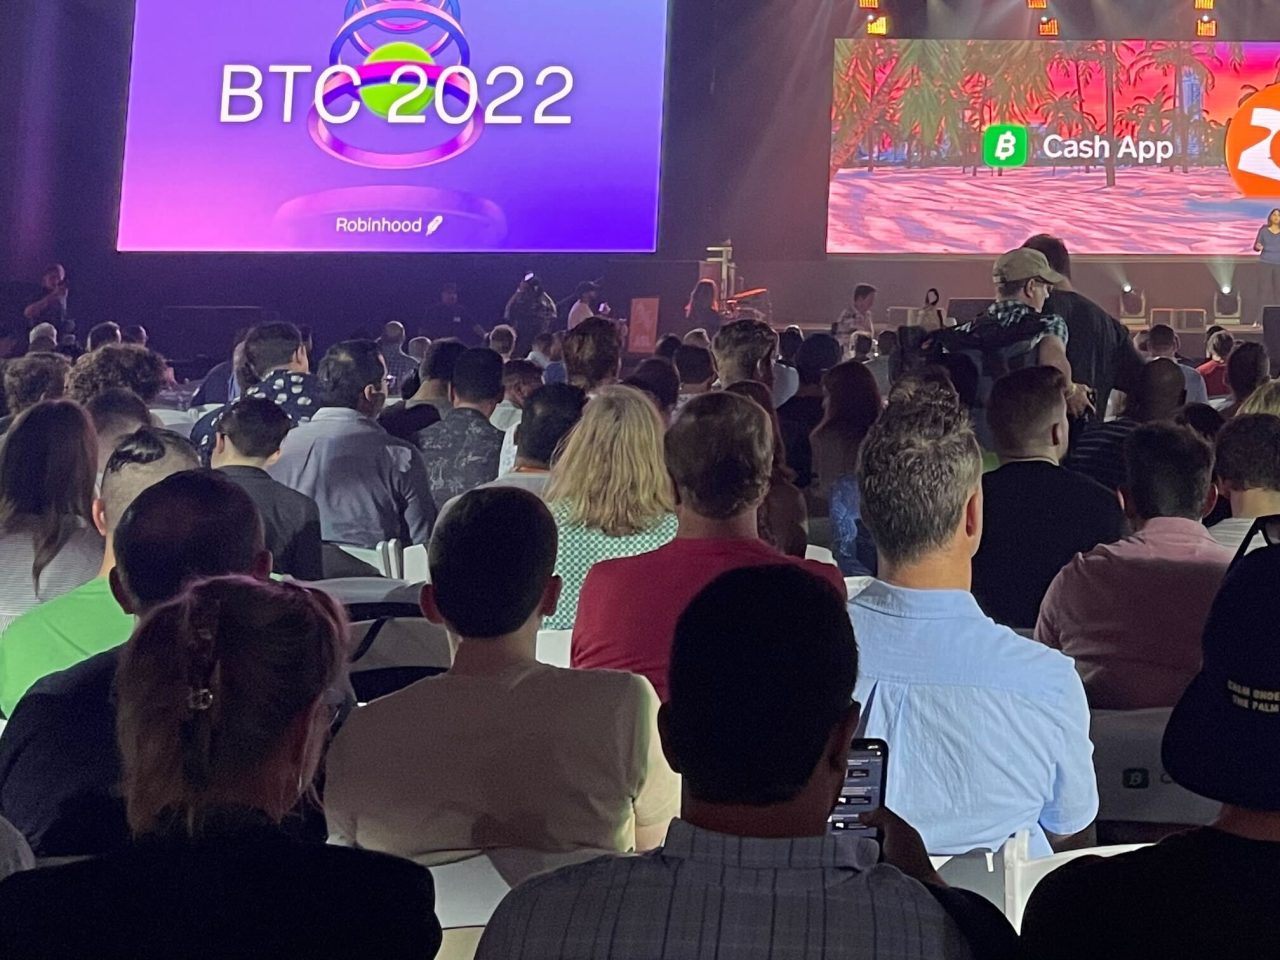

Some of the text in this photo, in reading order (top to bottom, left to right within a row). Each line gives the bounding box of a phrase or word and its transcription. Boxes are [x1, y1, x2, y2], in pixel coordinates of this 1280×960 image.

[219, 63, 575, 125] BTC 2022
[1043, 133, 1110, 159] Cash
[1117, 134, 1174, 164] App
[335, 216, 422, 234] Robinhood
[1252, 700, 1280, 713] PALM
